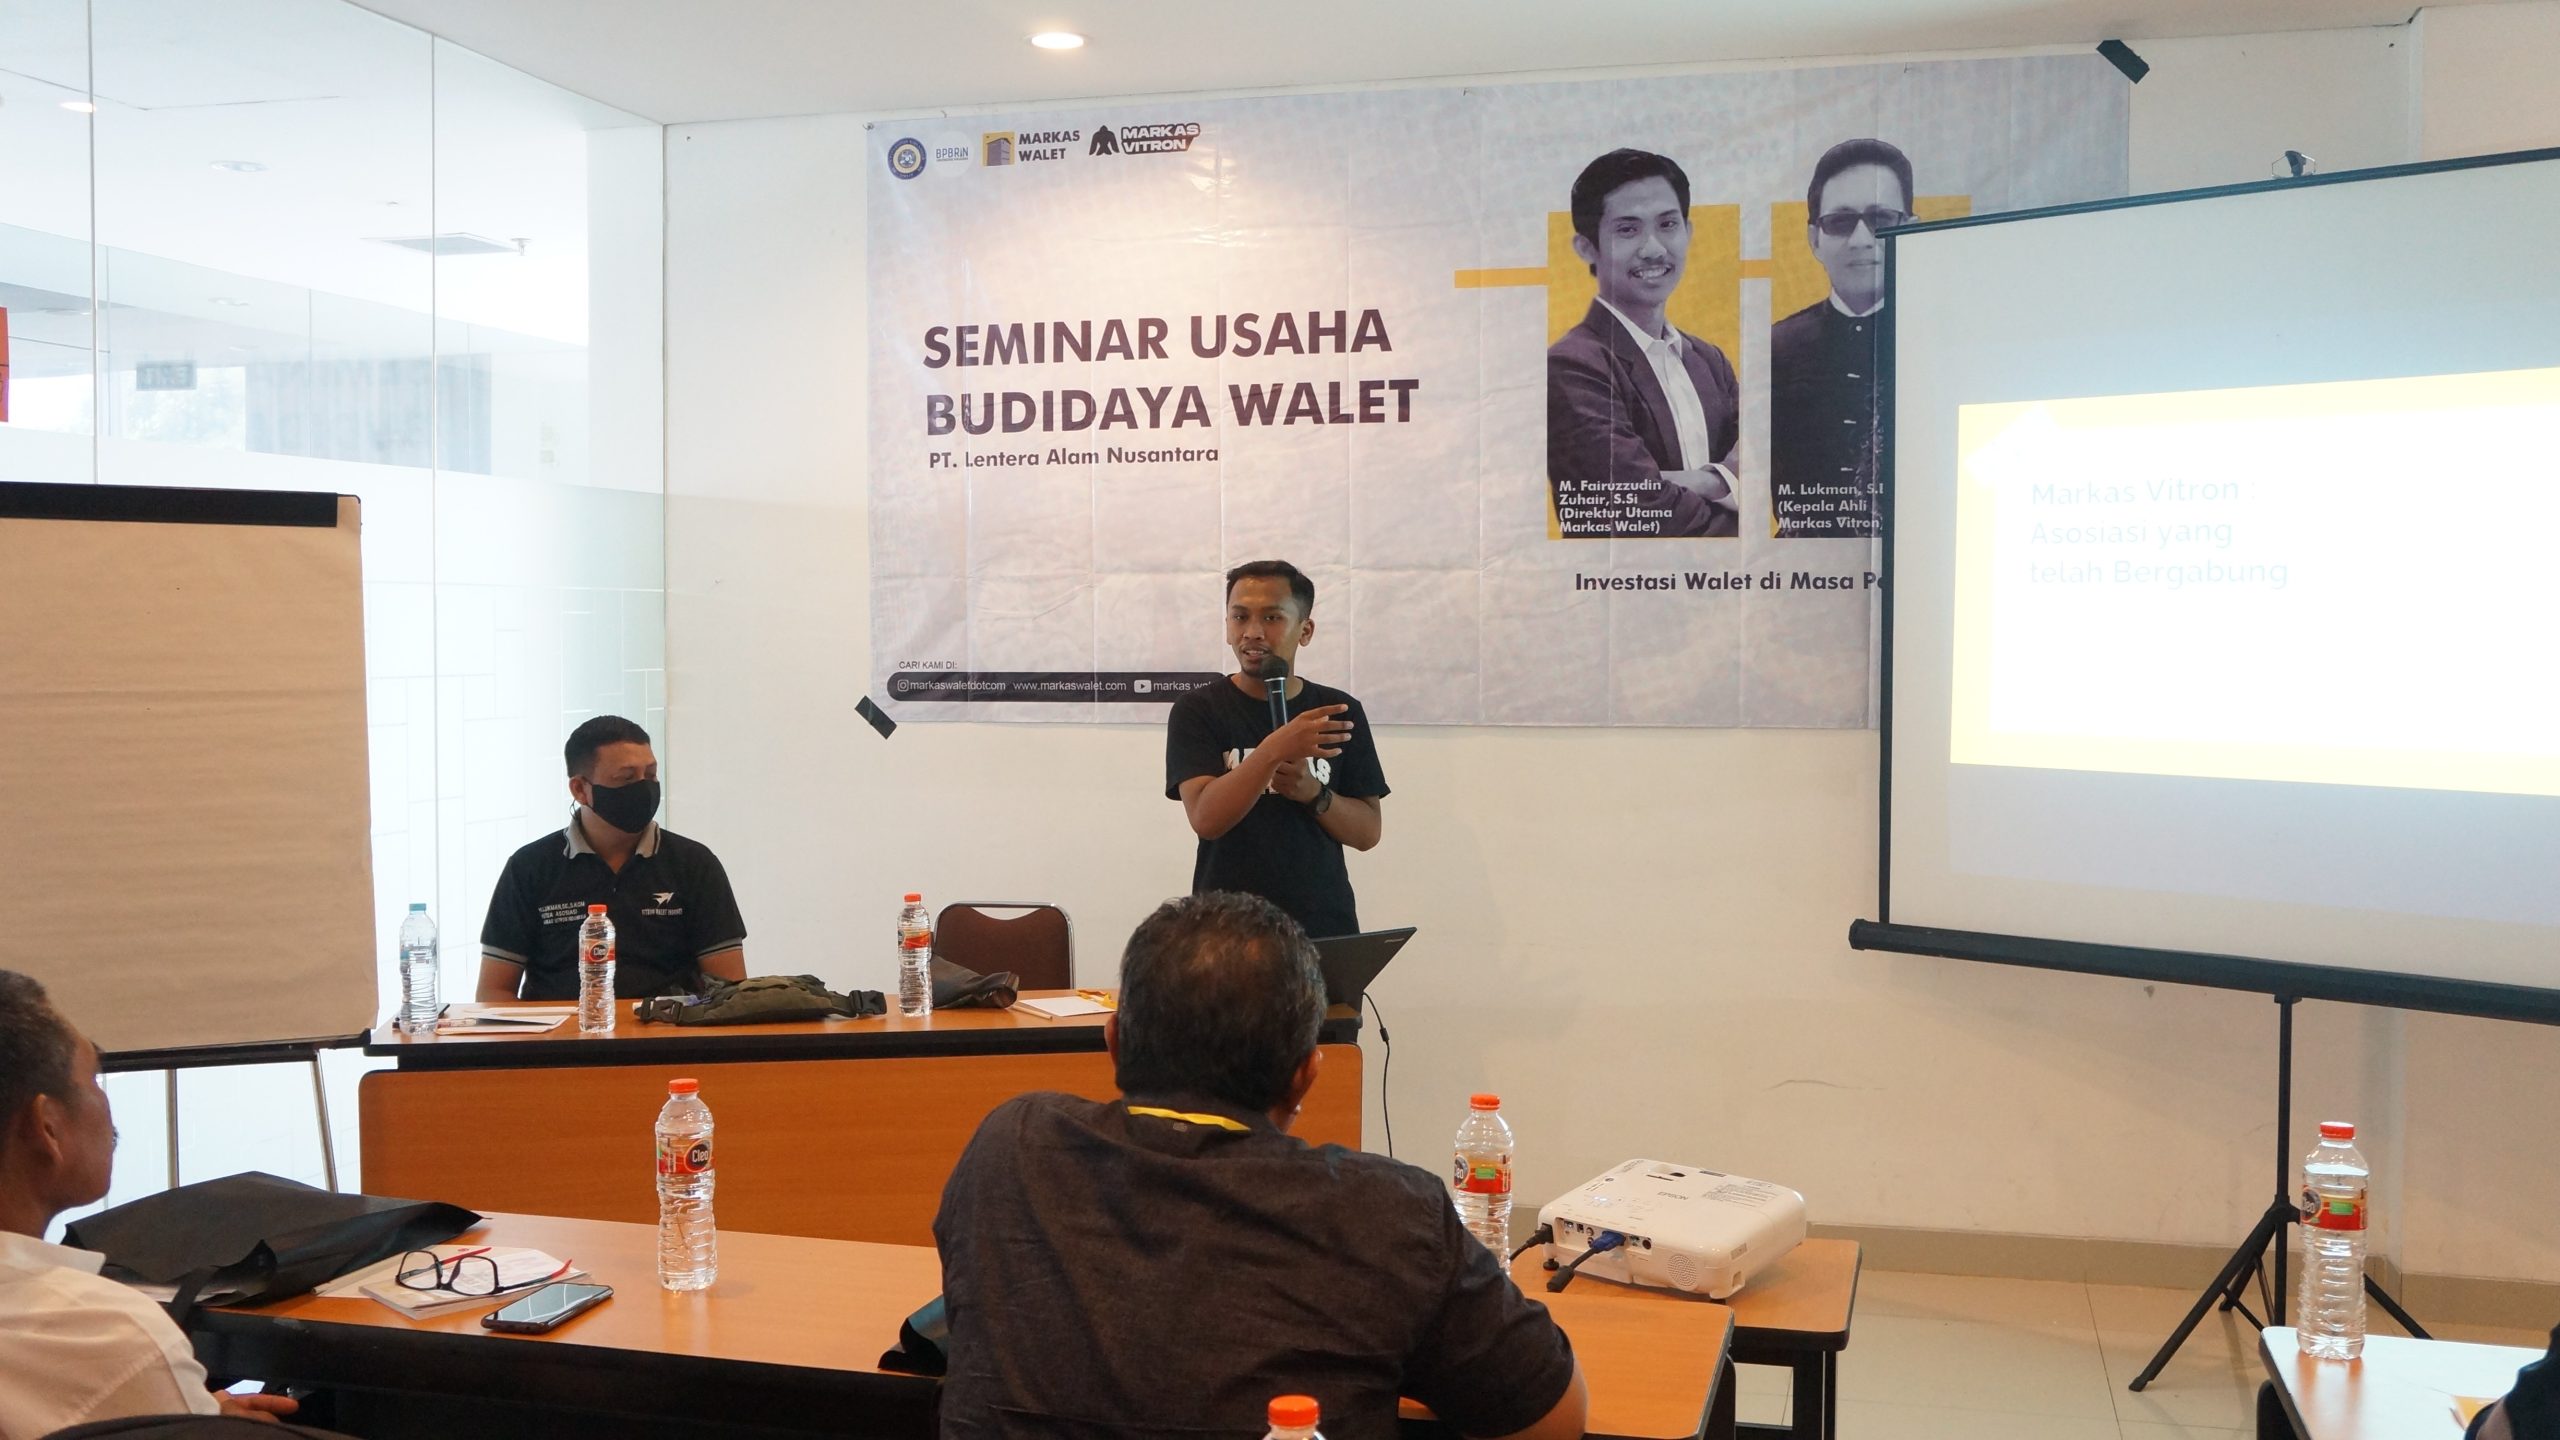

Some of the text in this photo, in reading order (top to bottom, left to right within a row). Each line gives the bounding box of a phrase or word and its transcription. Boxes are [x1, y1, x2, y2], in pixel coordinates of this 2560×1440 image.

[1019, 130, 1080, 145] MARKAS
[1122, 124, 1199, 139] MARKAS
[1123, 139, 1186, 153] VITRON
[1019, 148, 1066, 161] WALET
[923, 309, 1392, 369] SEMINAR USAHA
[927, 379, 1420, 436] BUDIDAYA WALET
[929, 446, 1219, 469] PT. Lentera Alam Nusantara
[1559, 479, 1662, 491] M. Fairuzzudin
[1778, 484, 1795, 495] M.
[1800, 483, 1862, 497] Lukman,
[2031, 481, 2136, 506] Markas
[2146, 477, 2240, 503] Vitron
[1559, 493, 1638, 506] Zuhair, S.Si
[1778, 499, 1867, 515] (Kepala Ahli
[1560, 506, 1673, 521] (Direktur Utama
[1560, 520, 1661, 535] Markas Walet)
[1778, 516, 1833, 529] Markas
[2030, 519, 2234, 550] Asosiasi yang
[1576, 572, 1676, 591] Investasi
[1684, 571, 1753, 590] Walet
[1760, 571, 1781, 590] di
[1790, 572, 1854, 590] Masa
[2029, 557, 2289, 590] telah Bergabung
[898, 660, 958, 669] CARI KAMI DI:
[910, 681, 1006, 691] markaswaletdotcom
[1013, 680, 1127, 691] www.markaswalet.com
[1153, 681, 1191, 691] markas
[692, 1149, 709, 1162] Cleo
